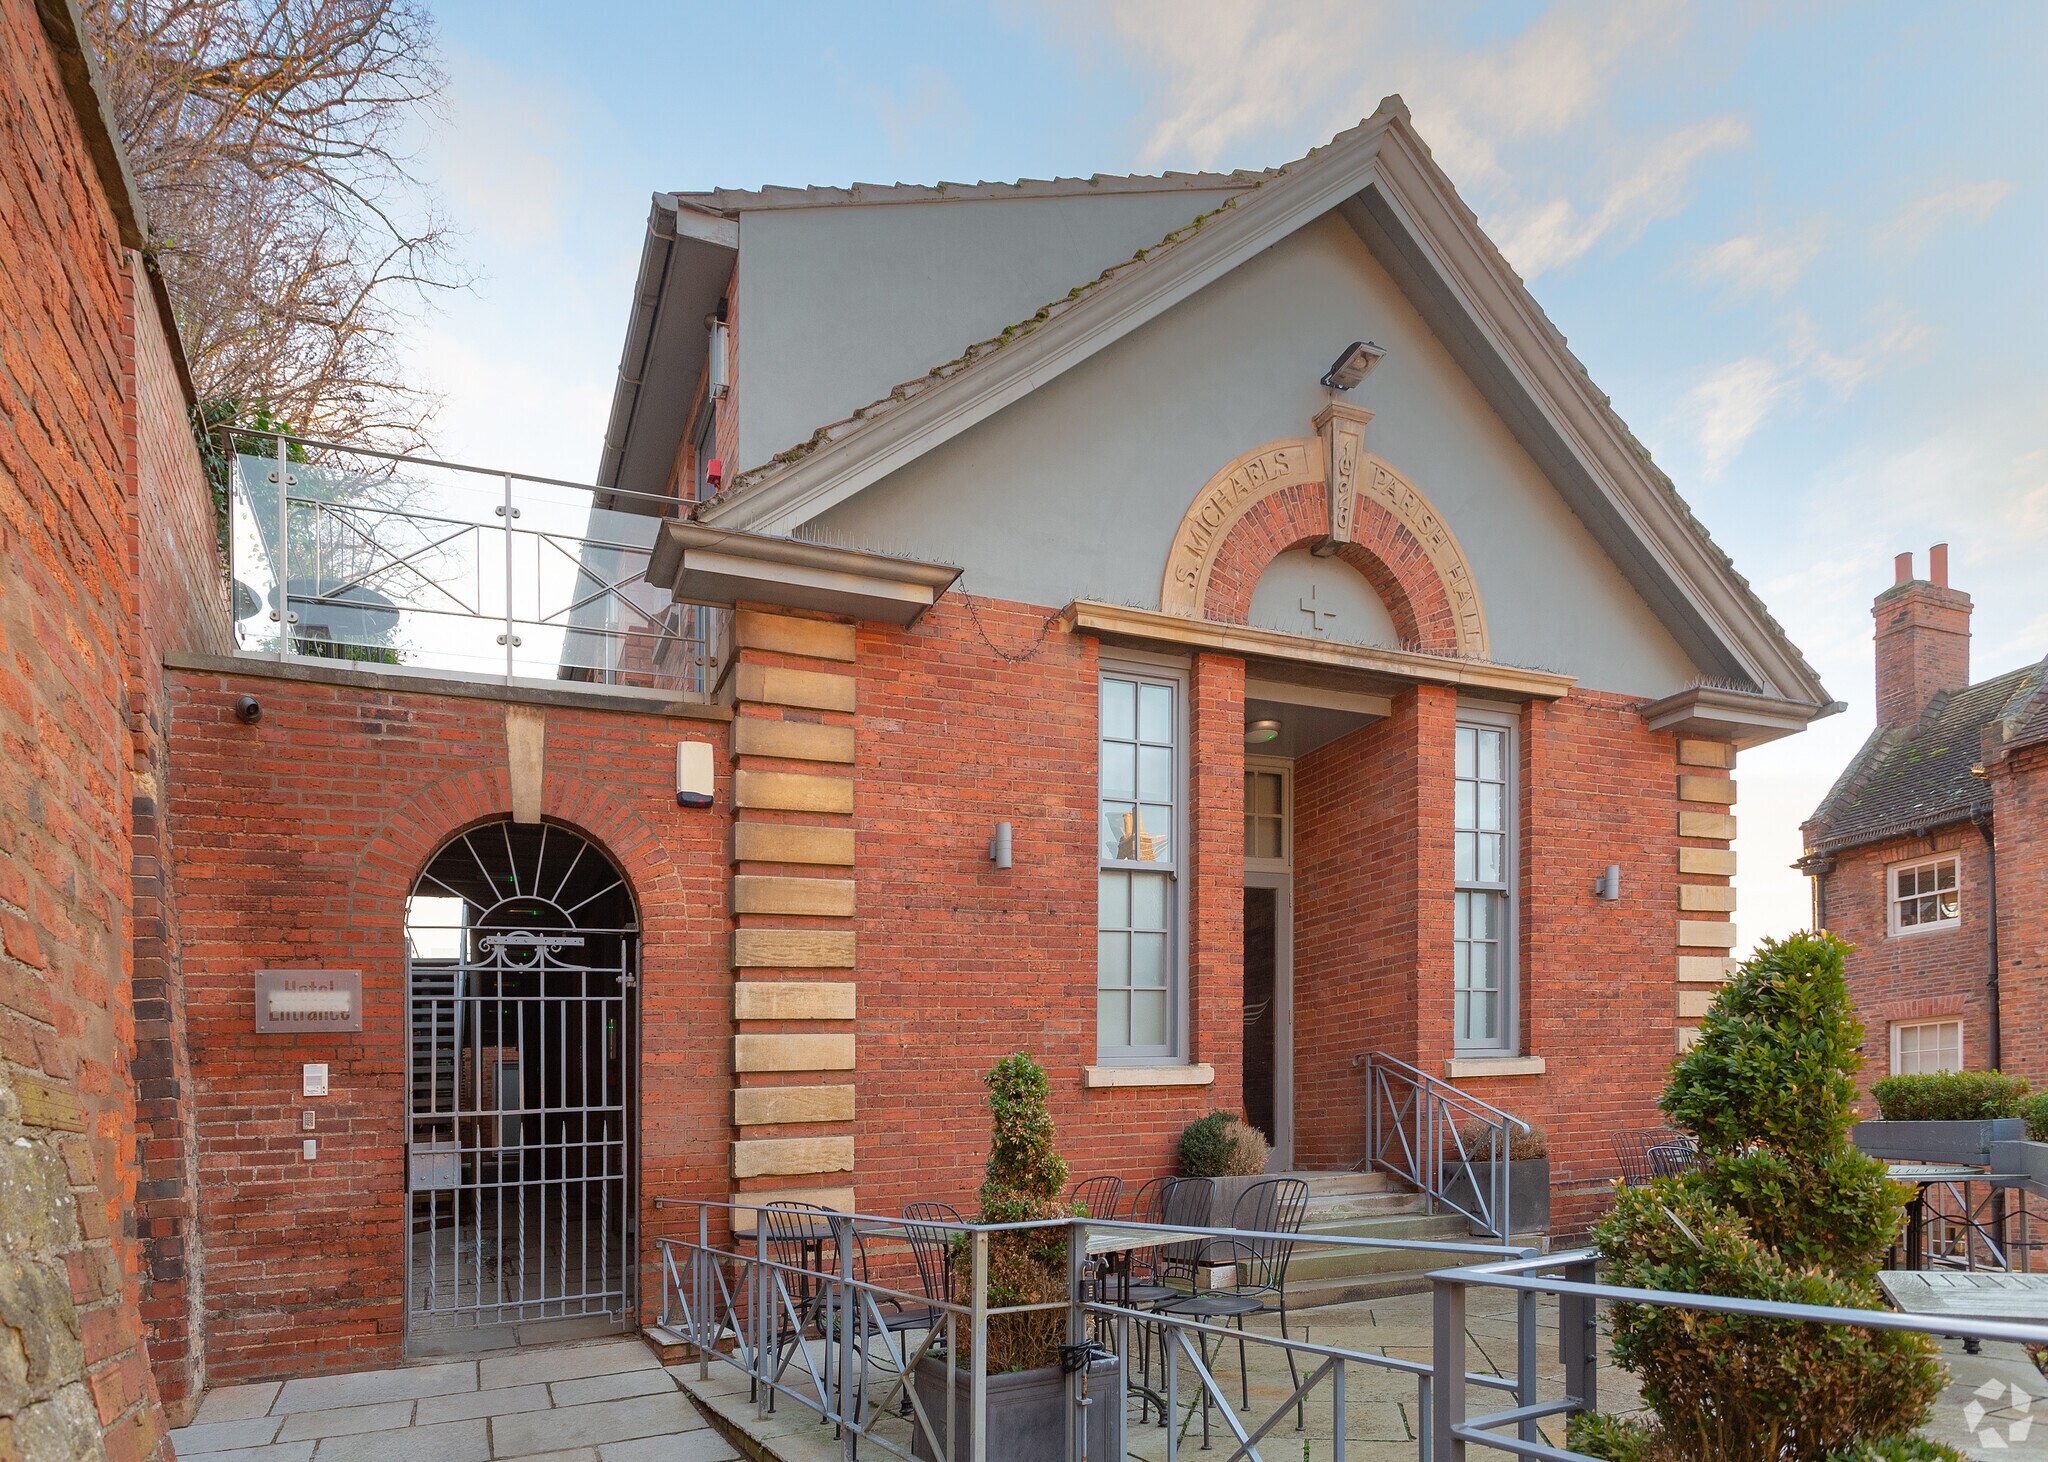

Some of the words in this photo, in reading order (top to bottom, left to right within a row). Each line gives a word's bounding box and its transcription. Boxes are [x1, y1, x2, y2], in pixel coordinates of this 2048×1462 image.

[1184, 452, 1290, 560] MICHAELS
[1372, 467, 1447, 553] PARISH
[1444, 565, 1480, 645] HALL
[269, 1004, 351, 1022] Entrance
